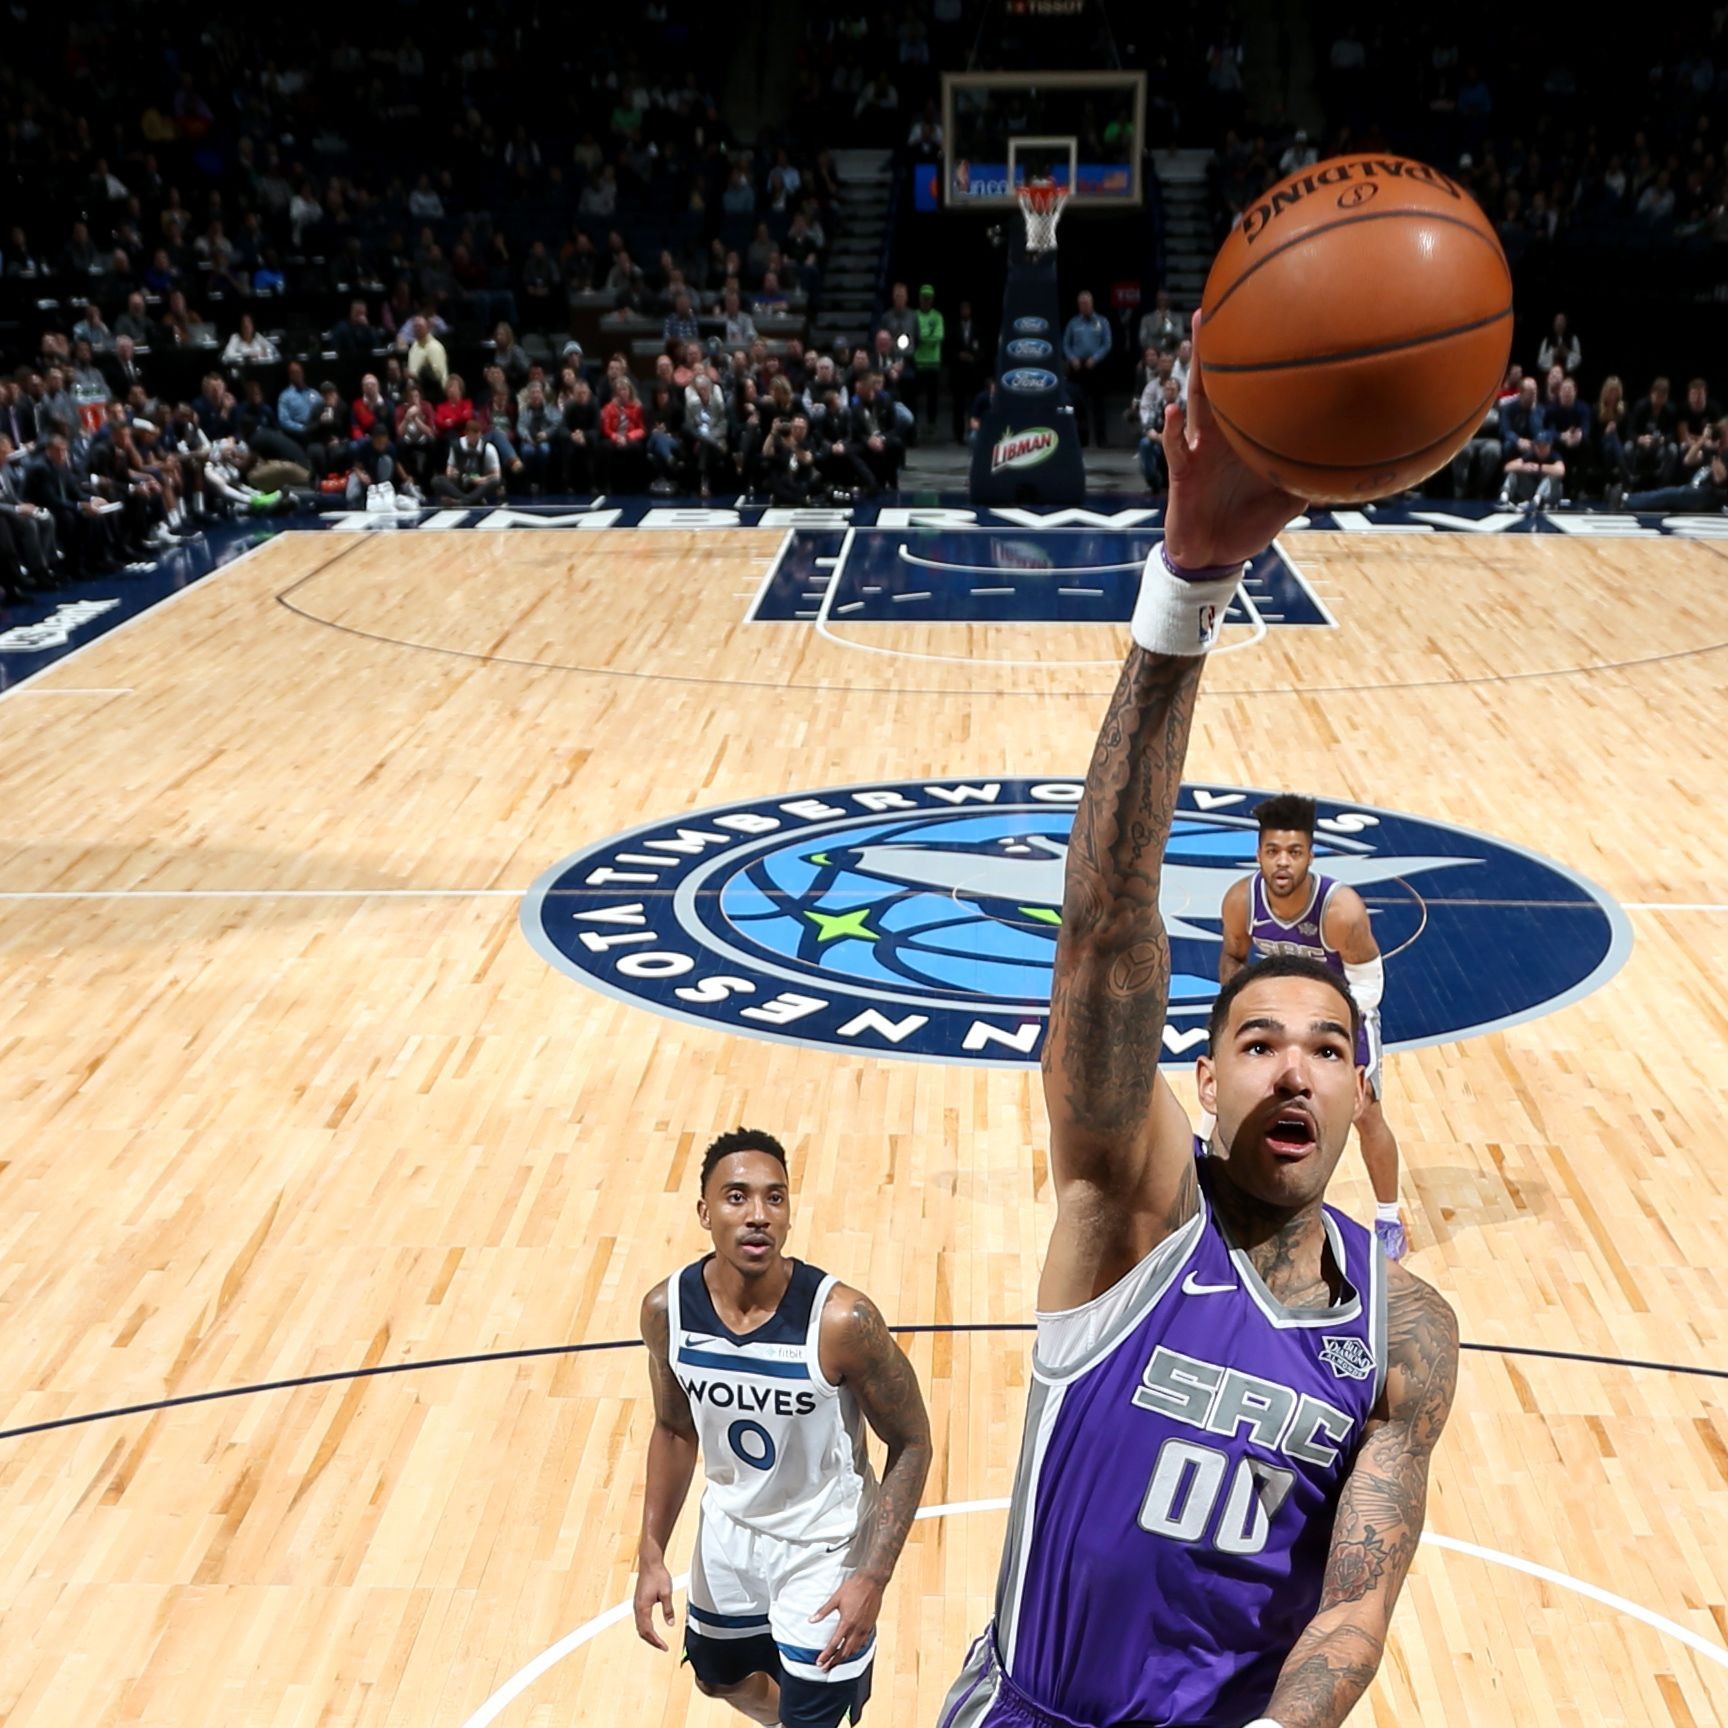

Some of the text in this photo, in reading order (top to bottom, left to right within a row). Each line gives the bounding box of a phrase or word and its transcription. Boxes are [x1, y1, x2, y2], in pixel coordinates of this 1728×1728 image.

[993, 433, 1052, 469] LIBMAN
[585, 783, 1380, 885] TIMBERWOVS
[778, 1348, 802, 1359] fitbit
[678, 1374, 817, 1416] WOLVES
[1131, 1344, 1354, 1468] SAC
[728, 1419, 776, 1471] 0
[1137, 1436, 1297, 1556] 00
